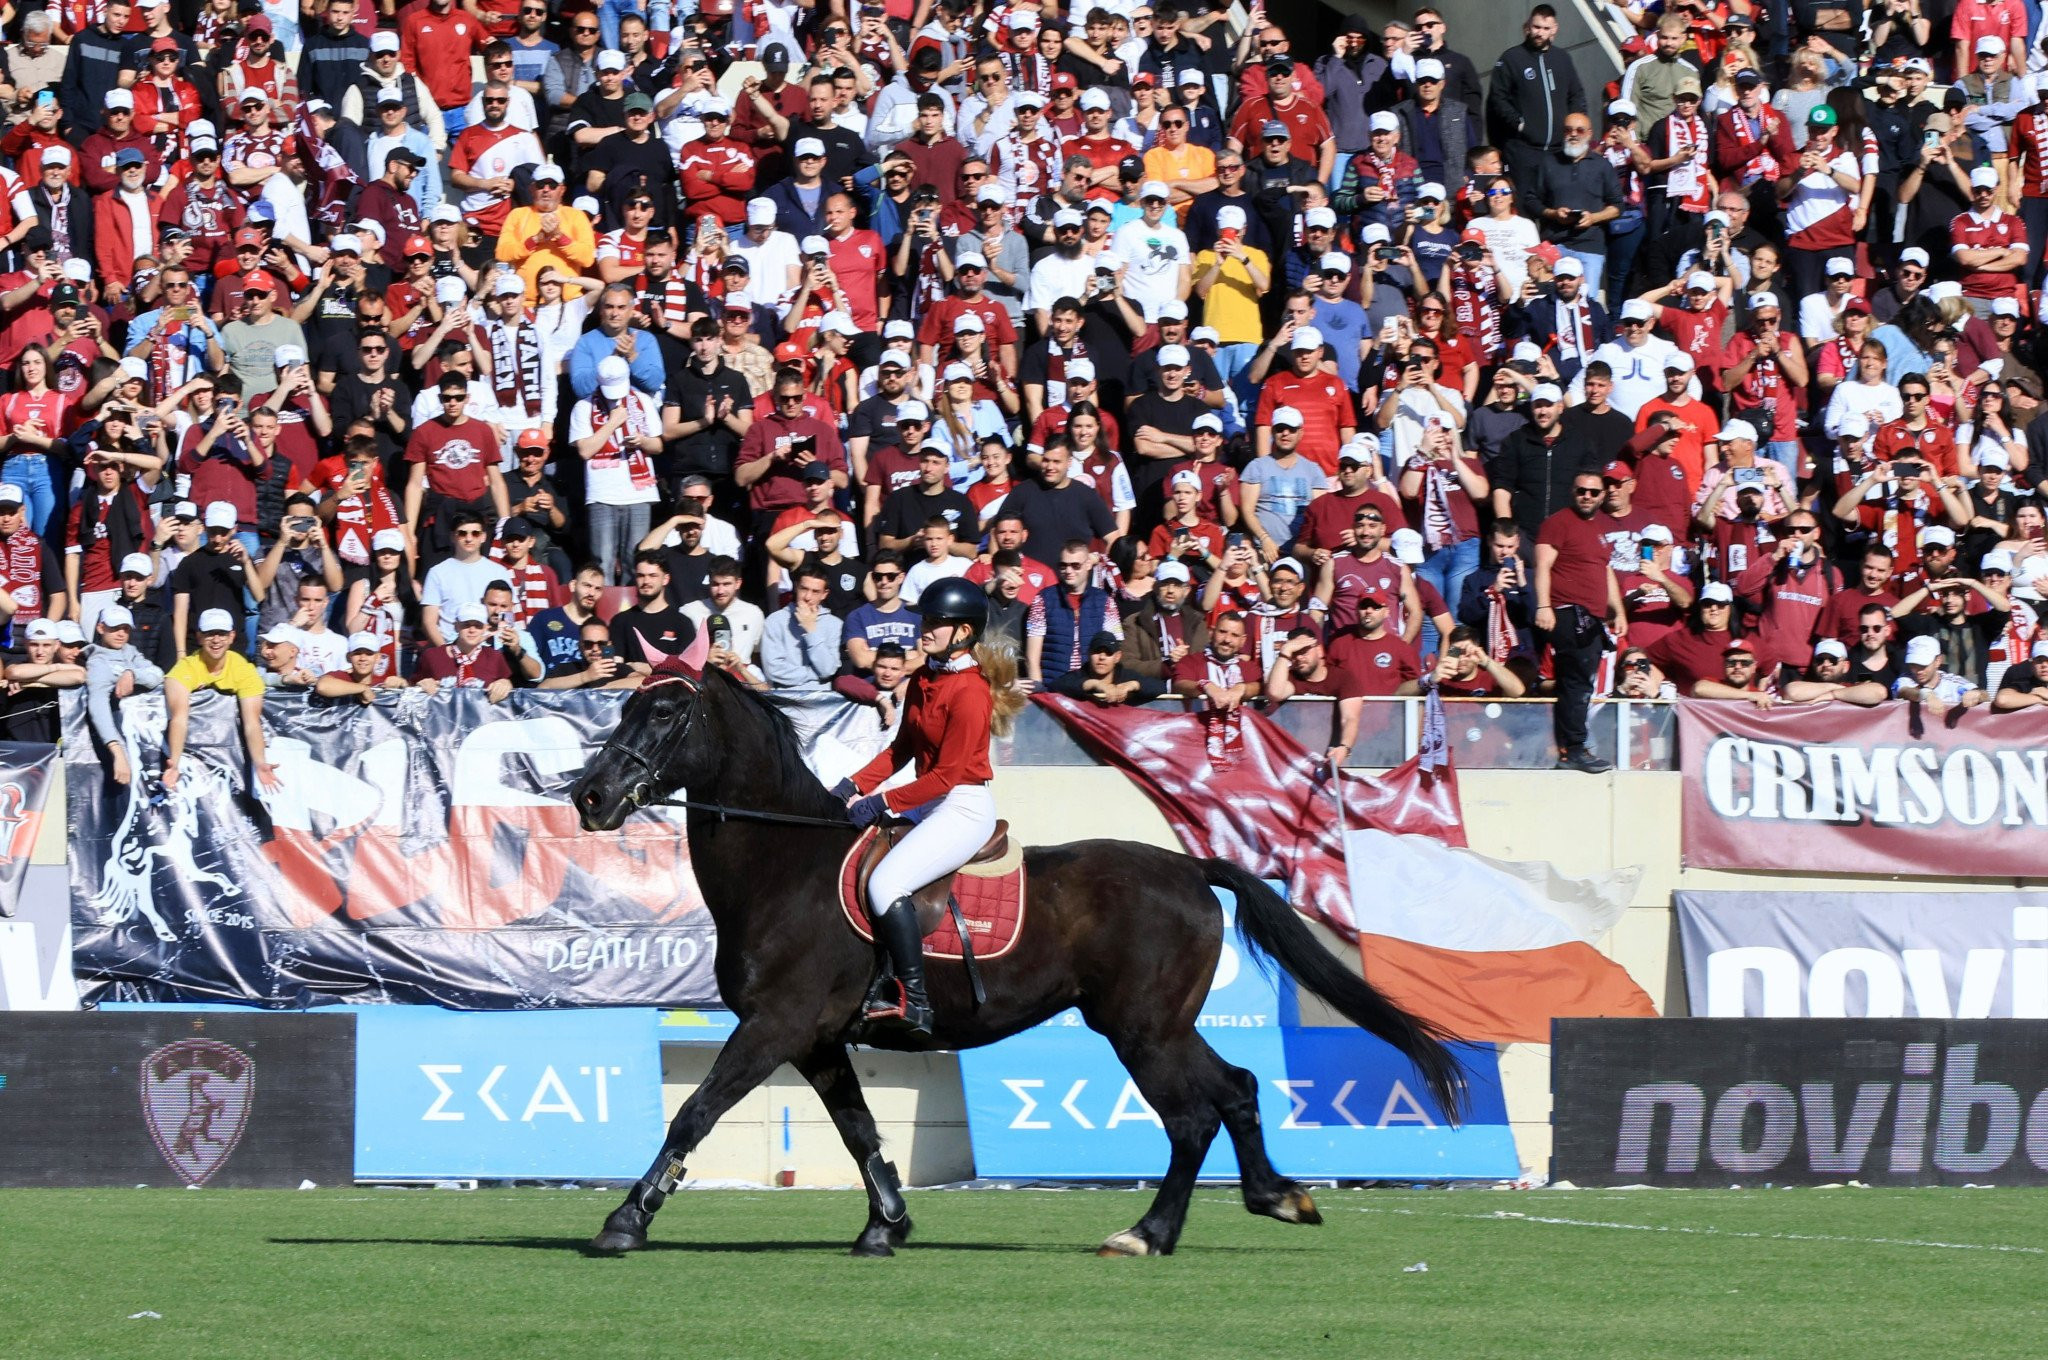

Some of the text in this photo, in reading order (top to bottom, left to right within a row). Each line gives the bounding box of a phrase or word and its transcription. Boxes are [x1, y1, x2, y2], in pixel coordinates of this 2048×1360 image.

[519, 329, 541, 401] FAITH
[865, 622, 915, 639] DISTRICT
[1706, 736, 2048, 826] CRIMSON
[224, 912, 255, 929] 2015
[654, 935, 698, 968] TO
[418, 1064, 622, 1123] ΣΚΑΪ
[1000, 1078, 1165, 1129] ΣΚΑ
[1614, 1043, 2048, 1173] novib
